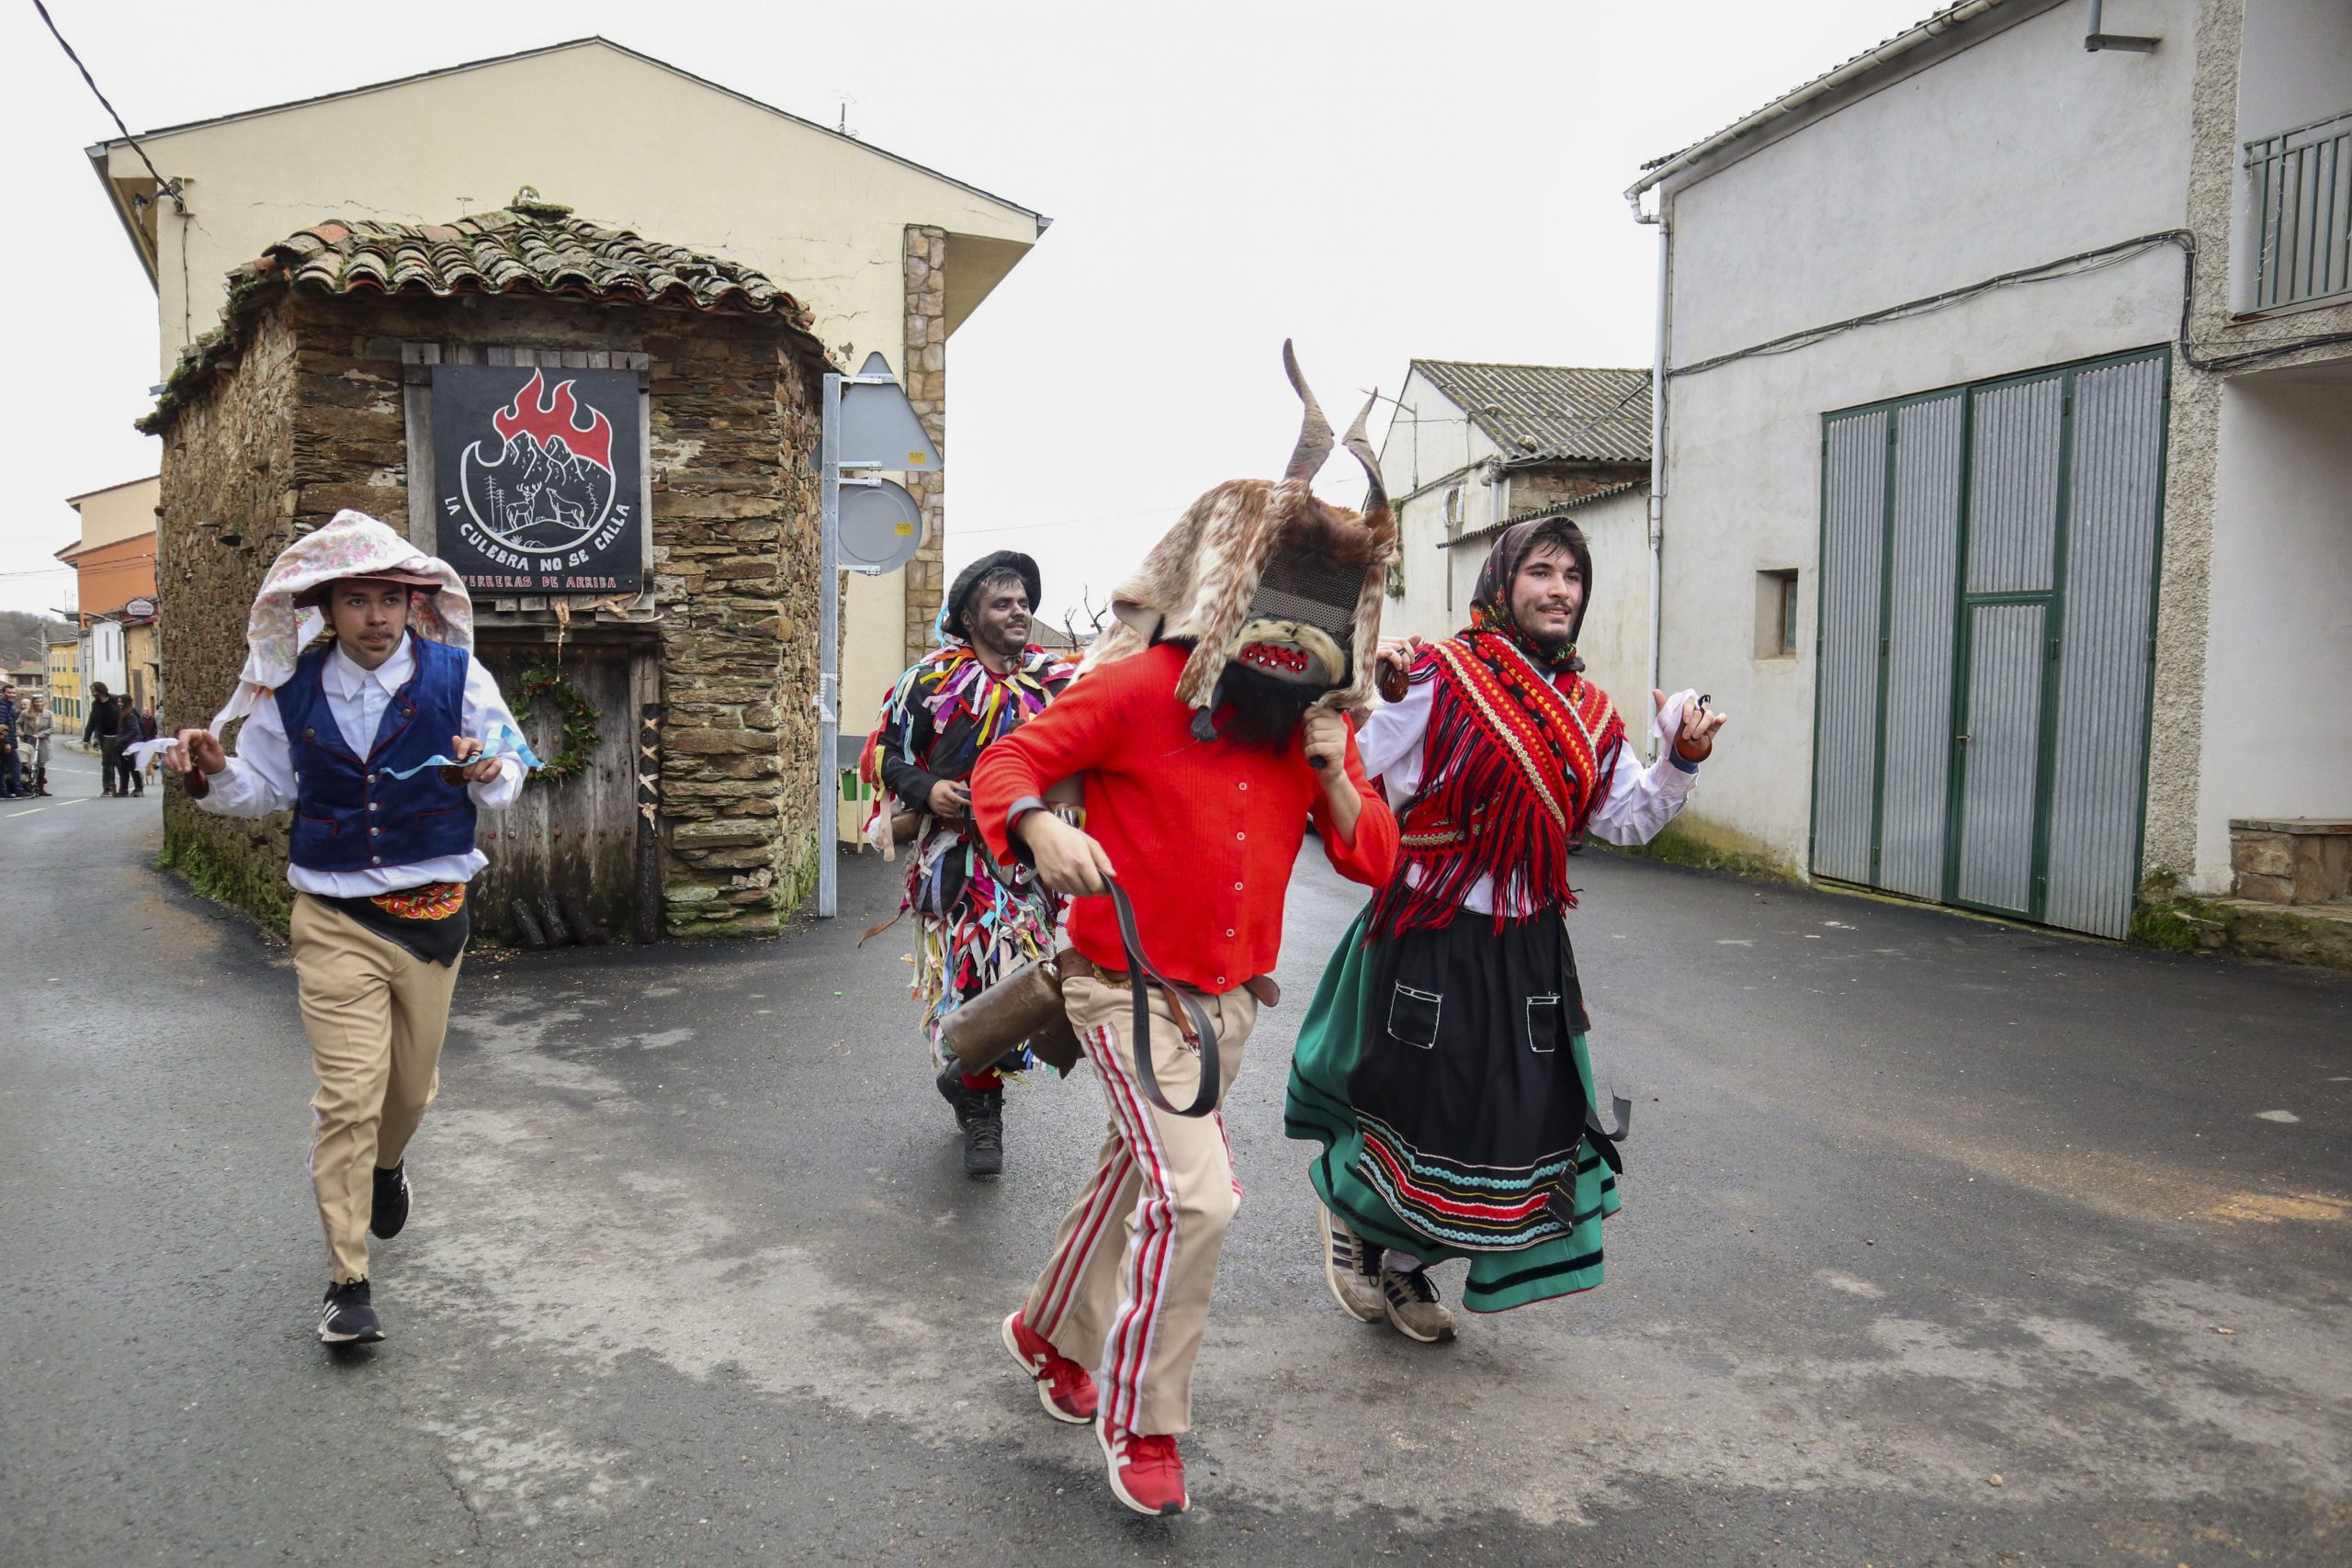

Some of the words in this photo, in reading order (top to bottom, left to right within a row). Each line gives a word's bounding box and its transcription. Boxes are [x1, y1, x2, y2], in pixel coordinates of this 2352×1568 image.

[444, 496, 461, 516] LA
[460, 523, 529, 571] CULEBRA
[540, 558, 562, 571] NO
[568, 549, 590, 568] SE
[594, 503, 630, 551] CALLA
[461, 575, 533, 587] FERRERAS
[542, 576, 559, 587] DE
[565, 576, 616, 588] ARRIBA
